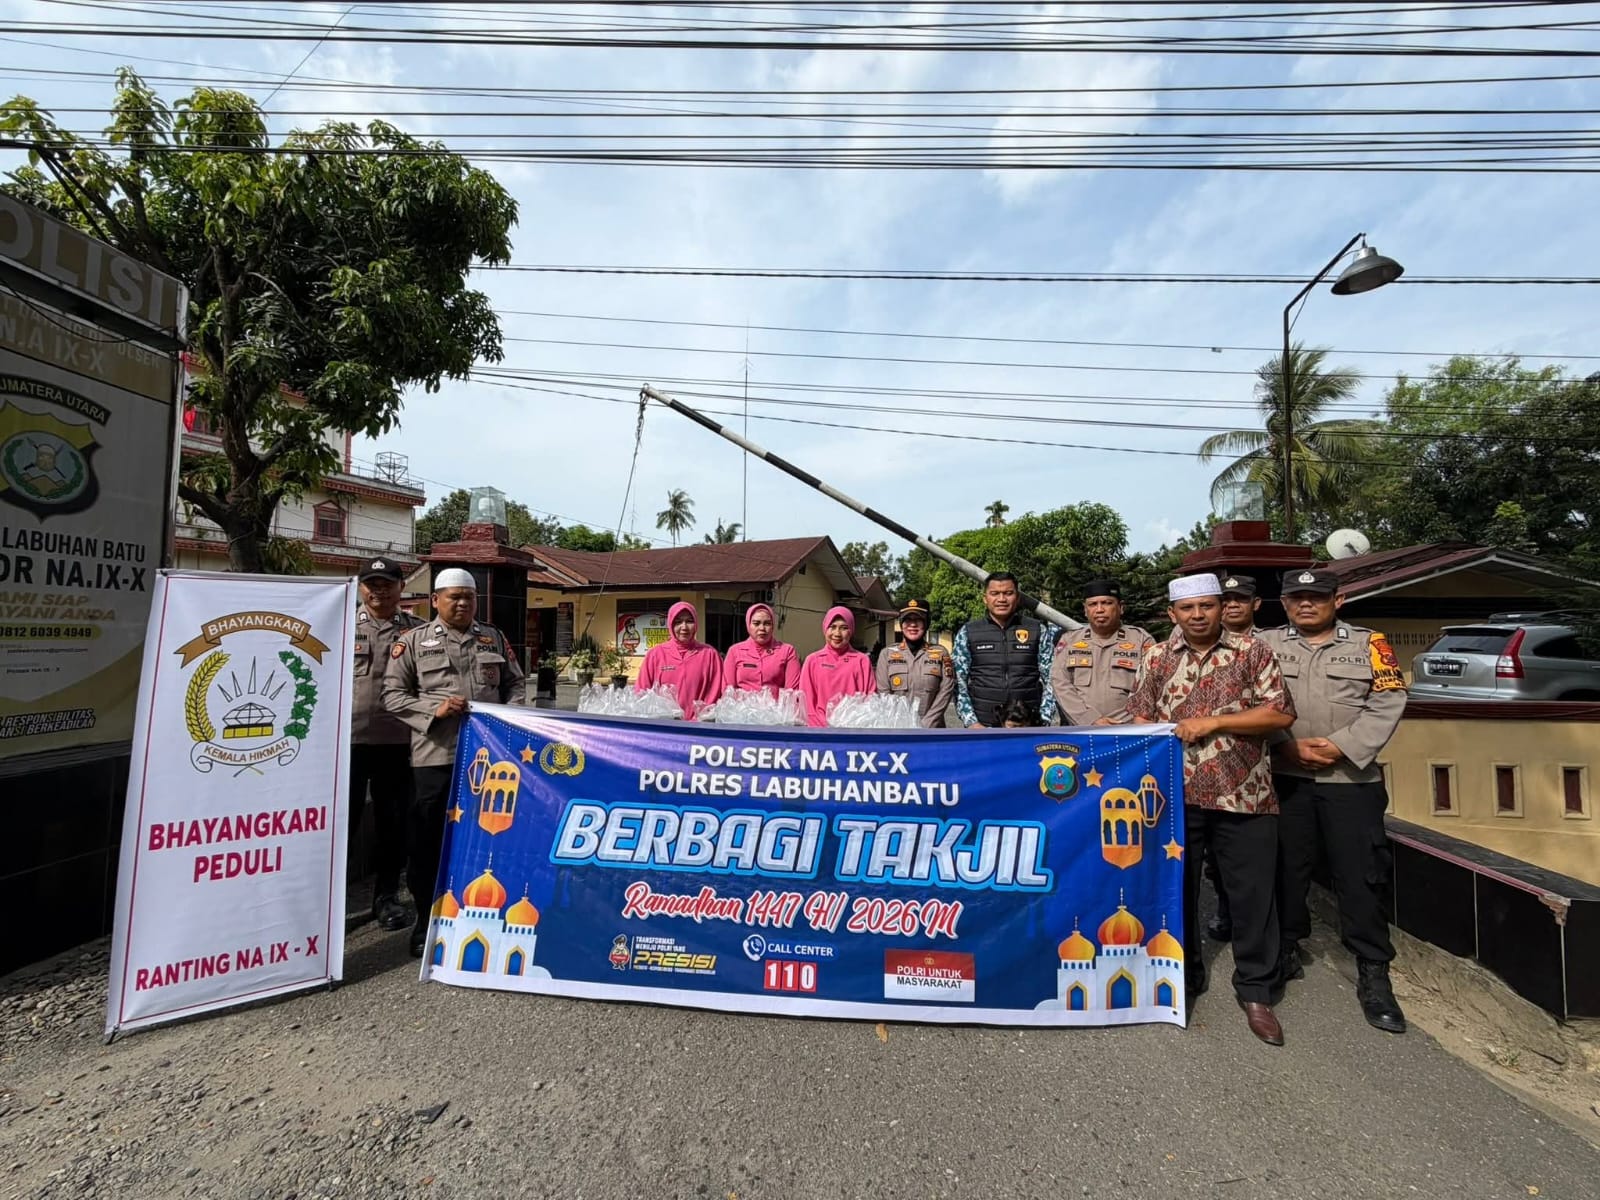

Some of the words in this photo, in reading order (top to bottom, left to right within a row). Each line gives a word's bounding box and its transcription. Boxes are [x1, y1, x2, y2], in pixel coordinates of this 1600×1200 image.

[66, 395, 106, 423] UTARA
[2, 526, 97, 558] LABUHAN
[103, 540, 146, 563] BATU
[42, 593, 89, 607] SIAP
[59, 608, 116, 621] ANDA
[207, 615, 305, 636] BHAYANGKARI
[1330, 656, 1366, 664] POLRI
[204, 744, 247, 763] KEMALA
[250, 738, 290, 762] HIKMAH
[689, 744, 792, 770] POLSEK
[800, 749, 838, 772] NA
[846, 750, 909, 775] IX-X
[639, 769, 742, 797] POLRES
[750, 775, 960, 807] LABUHANBATU
[148, 805, 327, 851] BHAYANGKARI
[552, 802, 825, 875] BERBAGI
[837, 817, 1049, 887] TAKJIL
[193, 846, 282, 883] PEDULI
[622, 881, 744, 924] Ramadhan
[745, 890, 803, 928] 1447
[847, 897, 920, 938] 2026
[135, 952, 231, 992] RANTING
[235, 946, 264, 971] NA
[269, 941, 289, 964] IX
[305, 935, 319, 957] X
[768, 943, 791, 954] CALL
[794, 944, 834, 957] CENTER
[766, 962, 815, 991] 110
[896, 965, 926, 977] POLRI
[928, 967, 963, 979] UNTUK
[896, 976, 963, 989] MASYARAKAT
